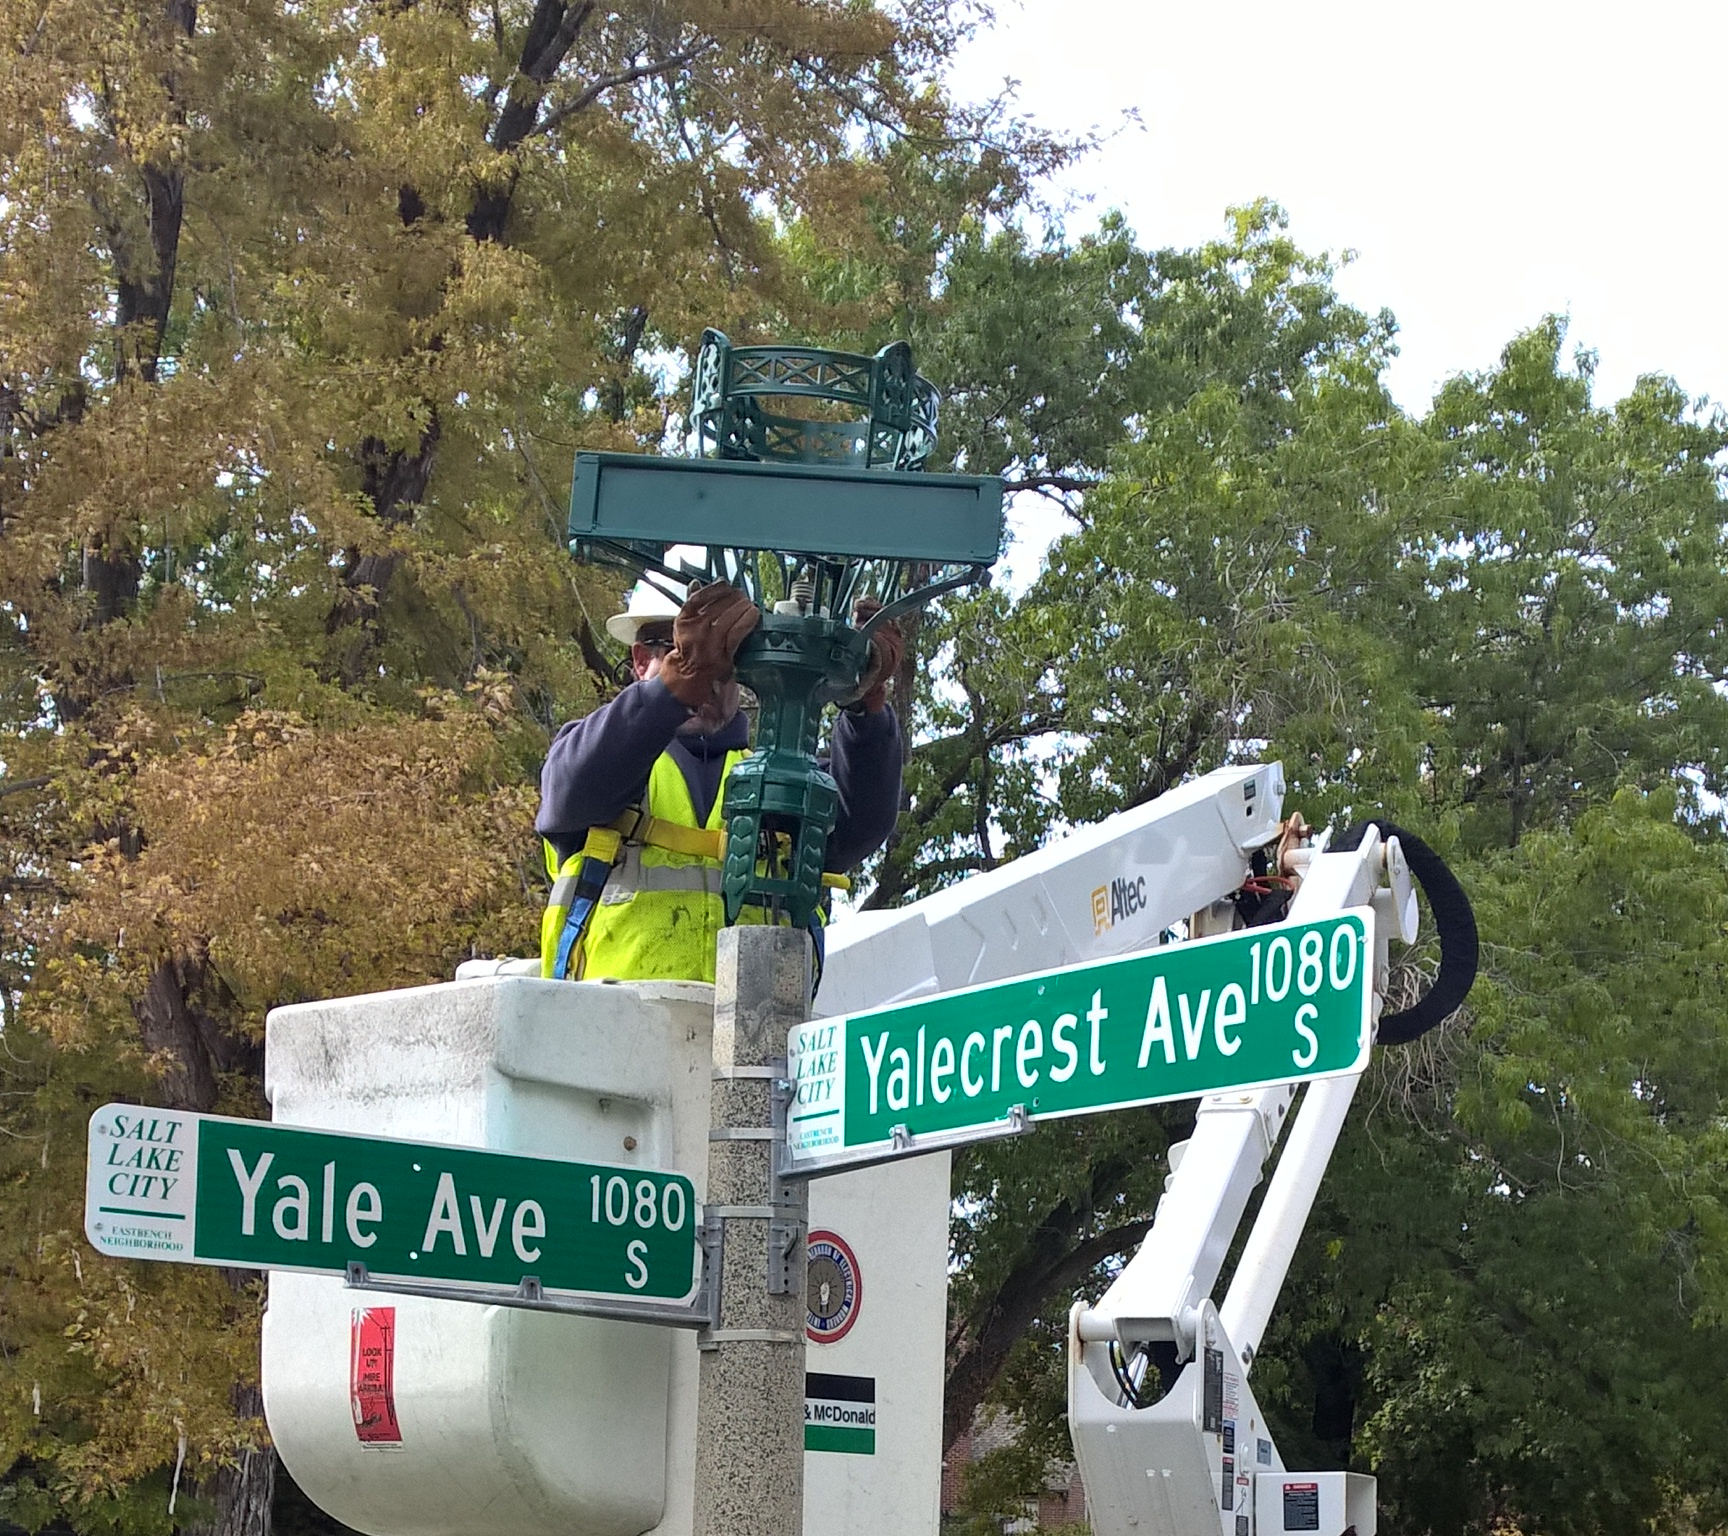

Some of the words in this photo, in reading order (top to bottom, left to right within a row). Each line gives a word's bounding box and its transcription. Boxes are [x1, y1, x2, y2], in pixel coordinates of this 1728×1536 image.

[1111, 876, 1147, 926] Altec
[1250, 922, 1358, 1006] 1080
[797, 1026, 837, 1055] SALT
[860, 989, 1108, 1115] Yalecrest
[1136, 976, 1247, 1070] Ave
[1292, 1003, 1319, 1069] S
[796, 1051, 839, 1080] LAKE
[797, 1077, 836, 1105] CITY
[109, 1114, 182, 1144] SALT
[106, 1143, 184, 1173] LAKE
[108, 1172, 179, 1201] CITY
[226, 1147, 384, 1248] Yale
[421, 1172, 547, 1263] Ave
[589, 1173, 686, 1232] 1080
[100, 1235, 184, 1252] NEIGHBORHOOD
[112, 1225, 172, 1241] EASTBENCH
[624, 1240, 649, 1290] S
[362, 1347, 382, 1356] LOOK
[814, 1404, 876, 1425] McDonald
